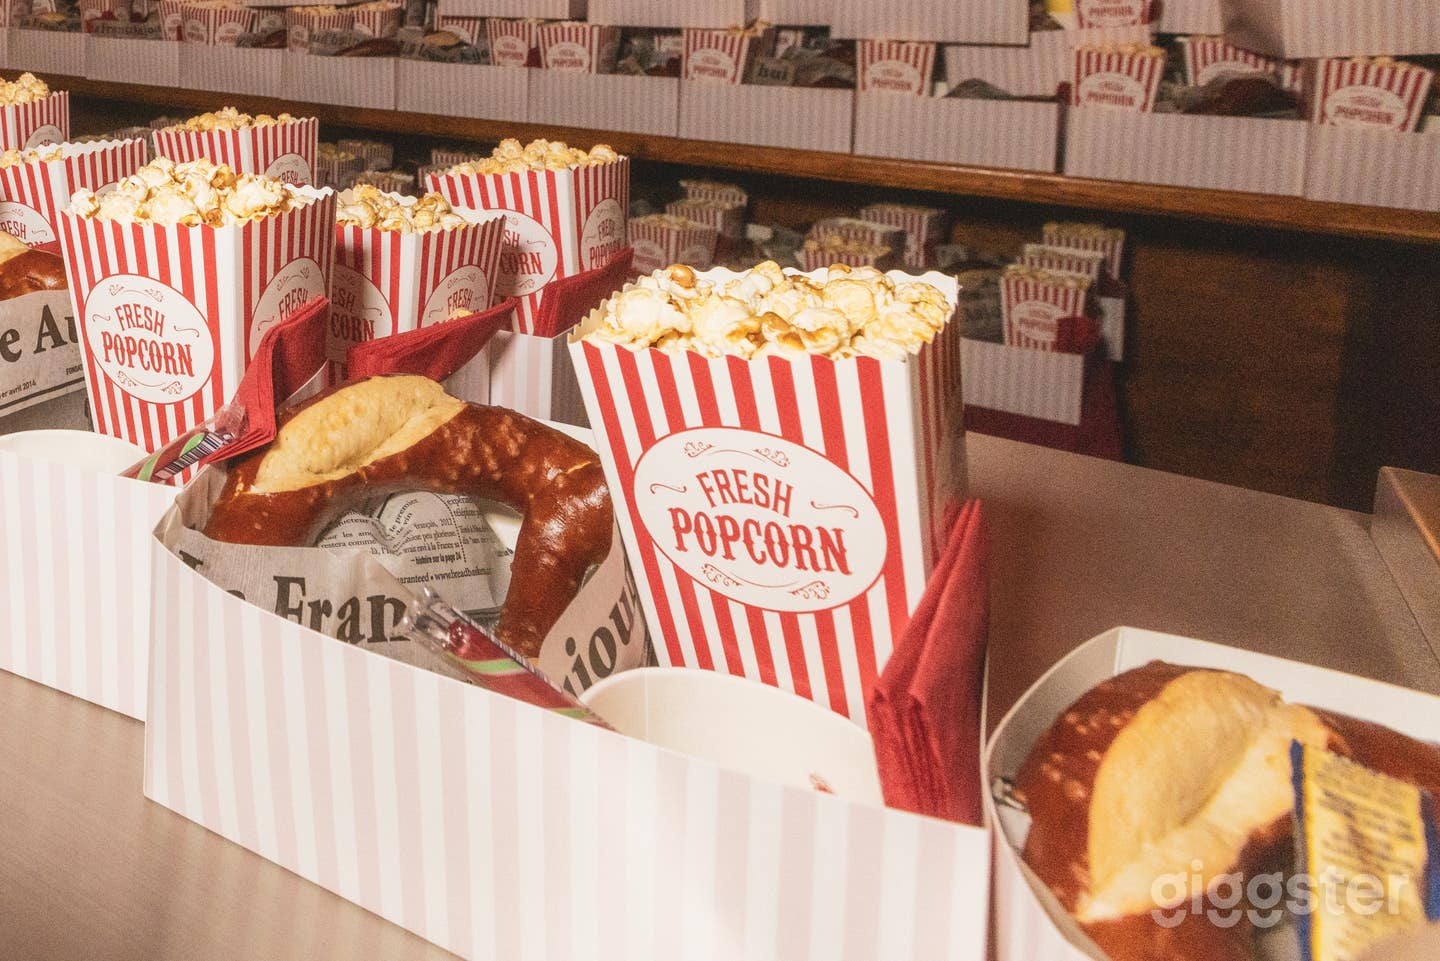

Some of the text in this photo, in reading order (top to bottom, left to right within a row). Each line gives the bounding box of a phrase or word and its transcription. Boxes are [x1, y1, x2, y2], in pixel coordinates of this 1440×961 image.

[115, 303, 166, 338] FRESH
[101, 330, 196, 378] POPCORN
[22, 379, 37, 391] 2014
[696, 469, 795, 518] FRESH
[668, 507, 853, 576] POPCORN
[398, 572, 429, 584] aranteed
[273, 575, 412, 644] Fran
